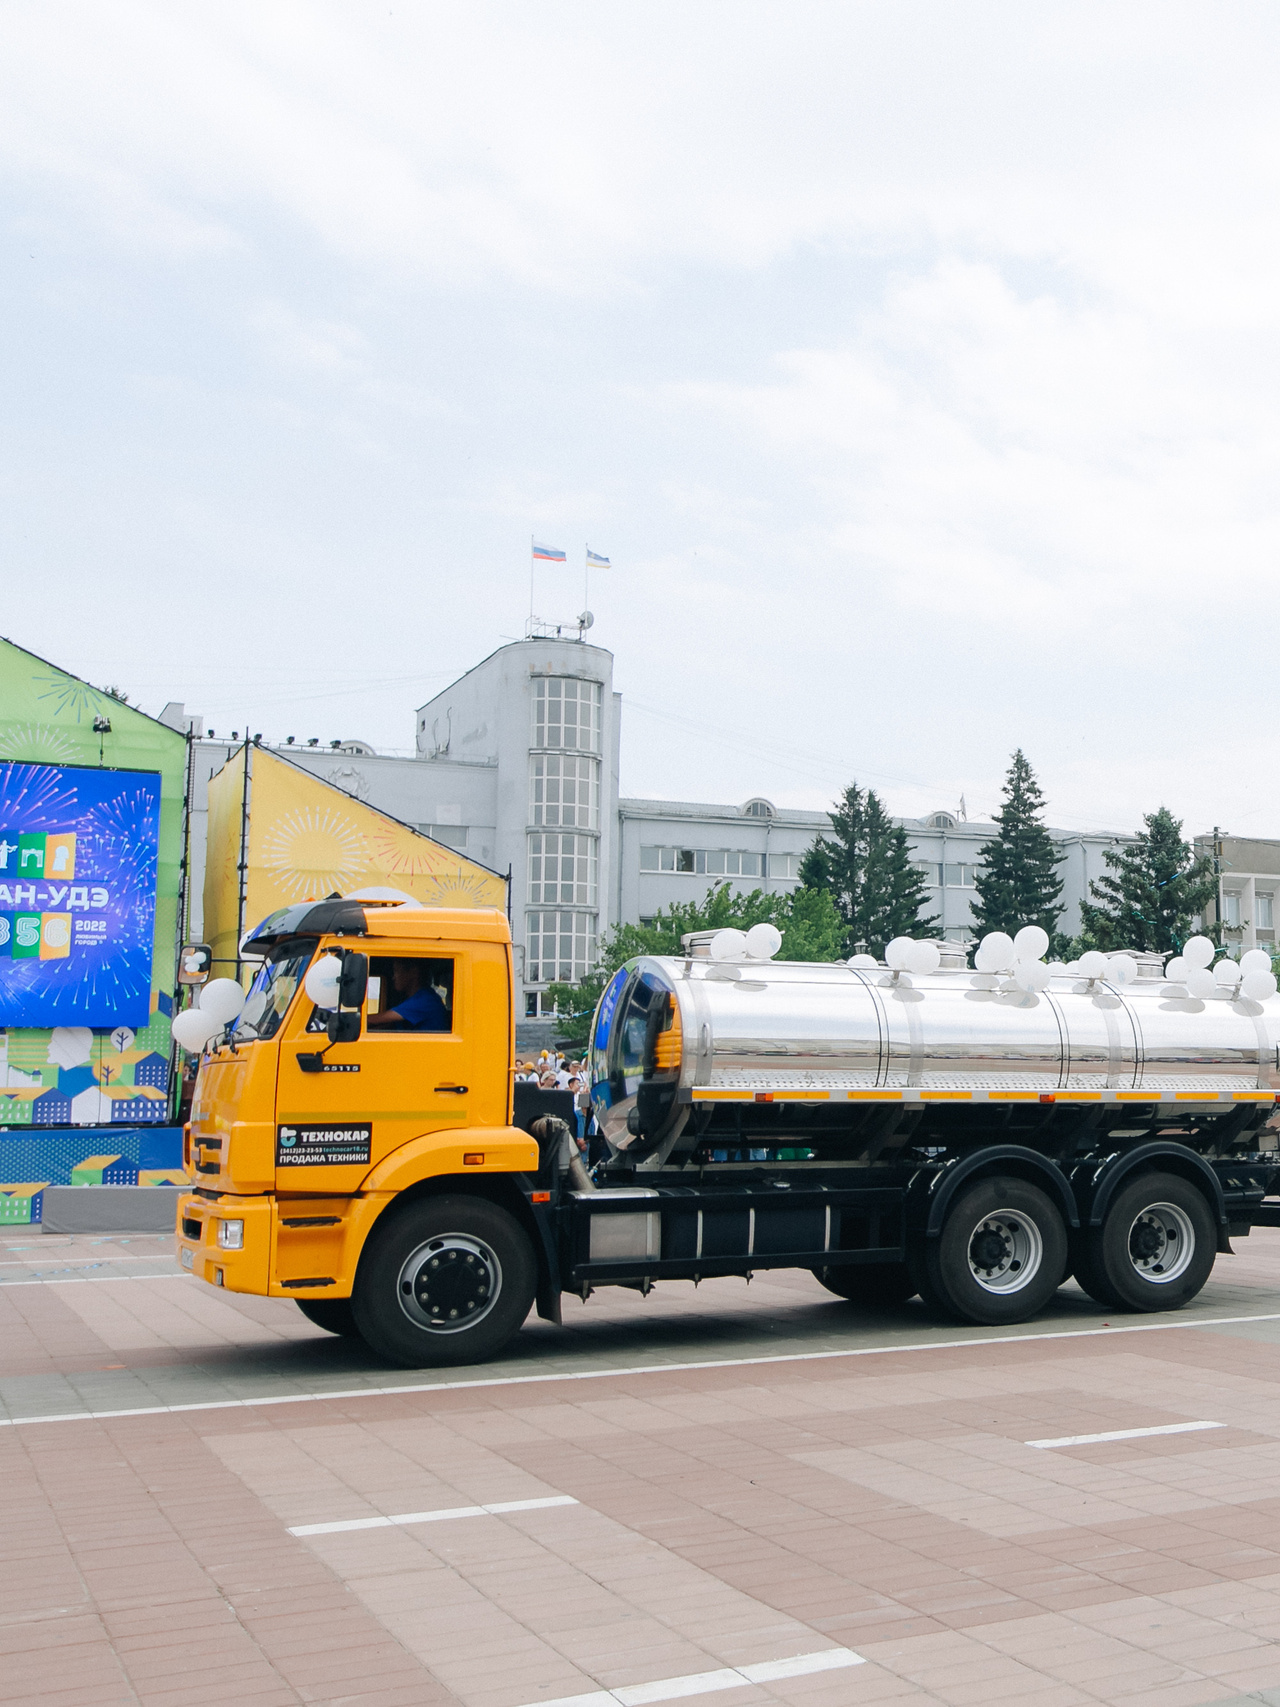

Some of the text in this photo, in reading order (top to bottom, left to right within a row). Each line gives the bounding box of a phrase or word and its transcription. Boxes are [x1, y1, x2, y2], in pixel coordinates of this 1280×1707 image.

[75, 920, 107, 932] 2022
[301, 1130, 369, 1143] ТЕХНОКАР
[279, 1153, 368, 1165] ПРОДАЖА ТЕХНИКИ
